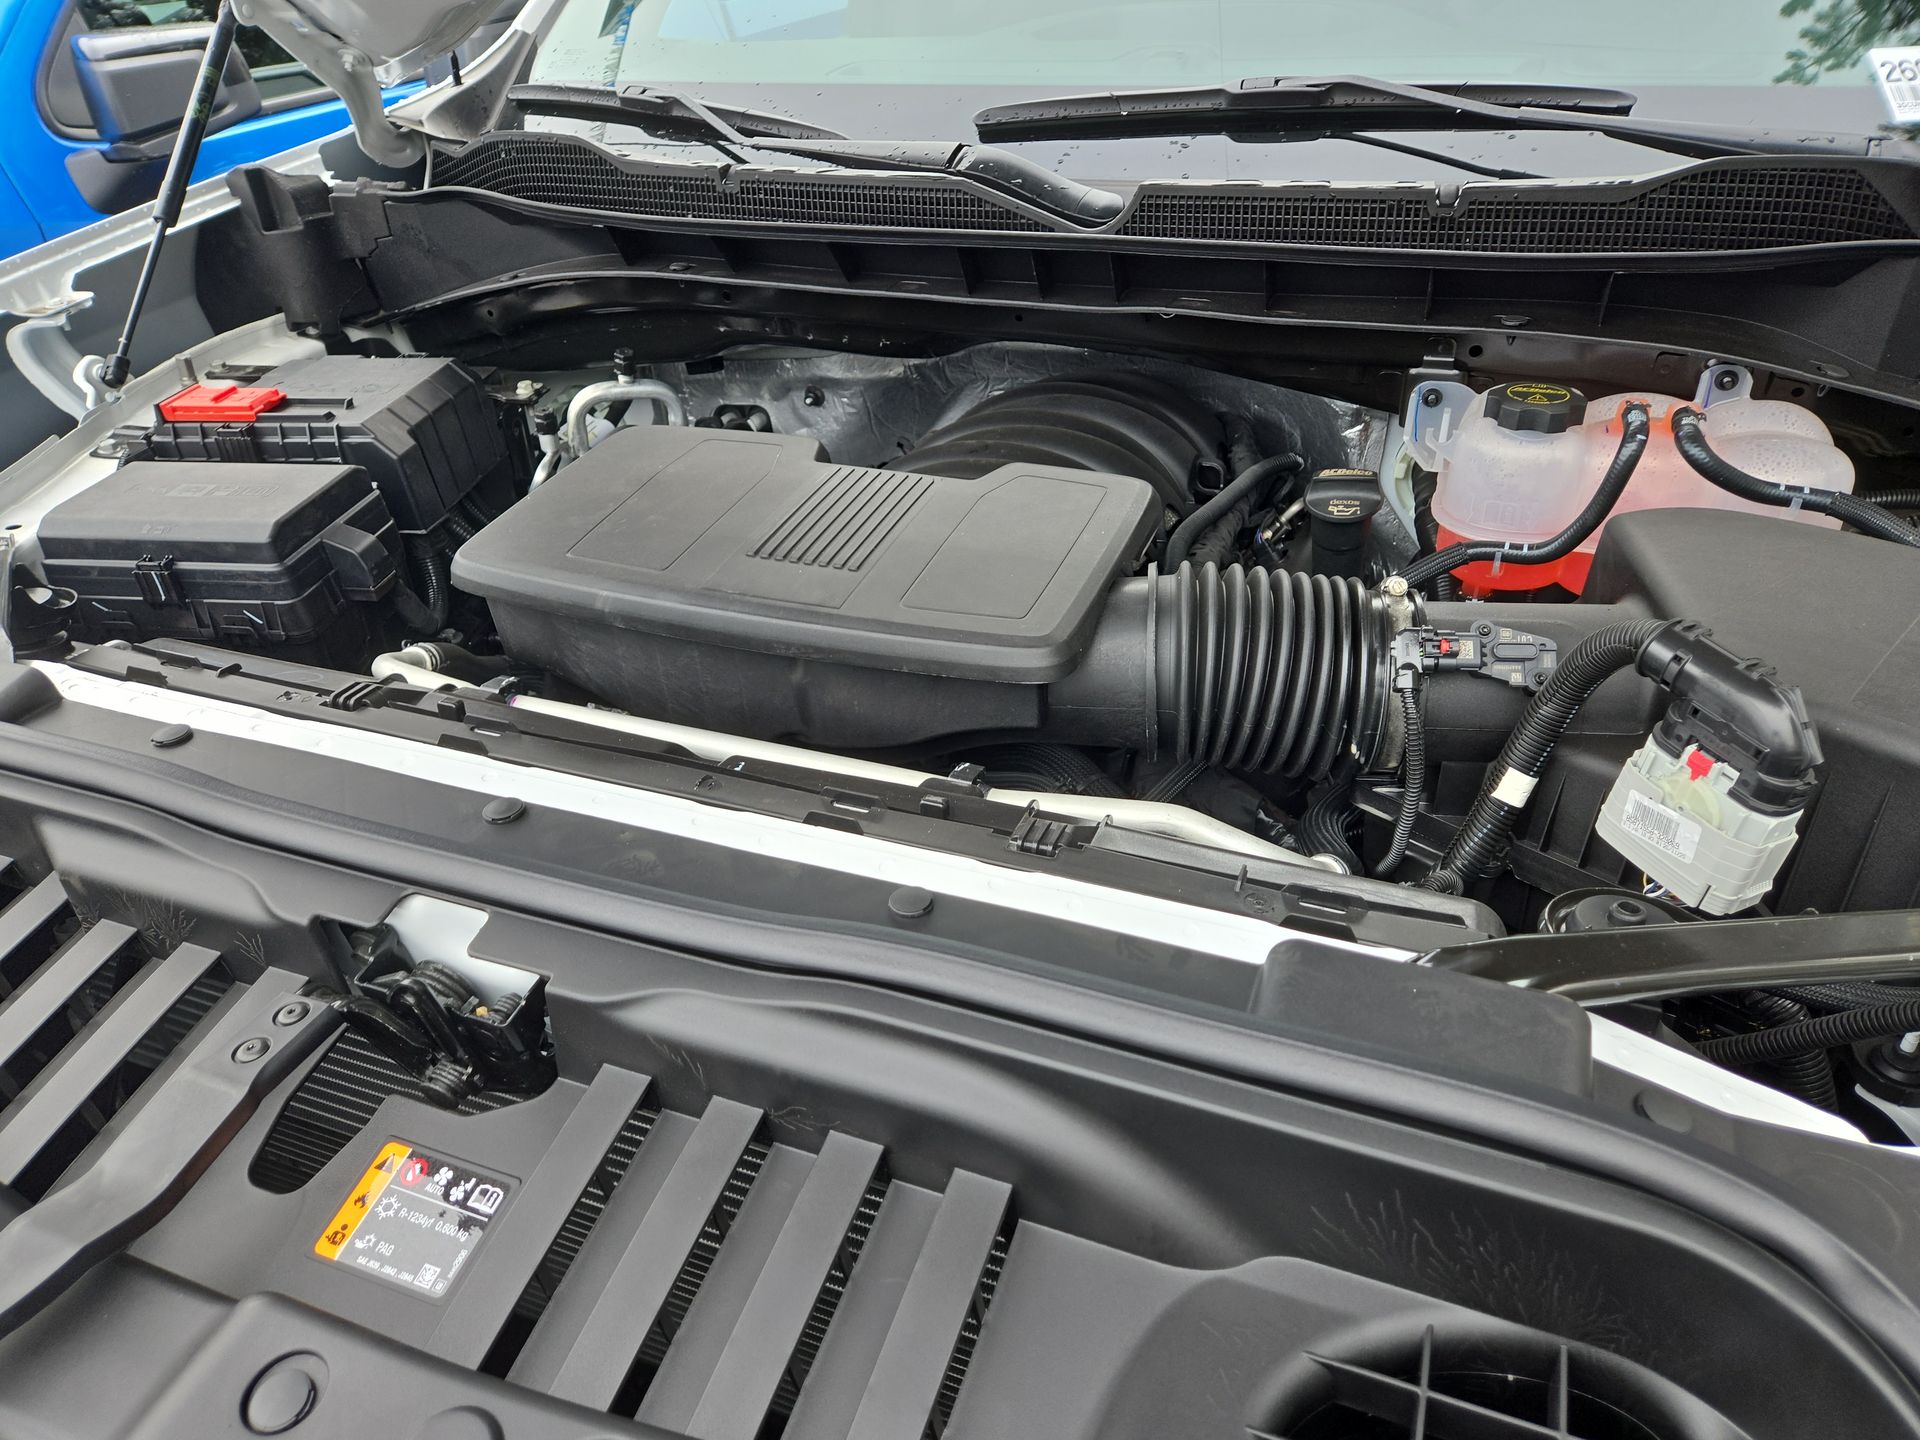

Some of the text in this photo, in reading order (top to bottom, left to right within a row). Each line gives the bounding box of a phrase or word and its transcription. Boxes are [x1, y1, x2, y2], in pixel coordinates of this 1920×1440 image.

[1880, 58, 1920, 82] 26
[1318, 468, 1374, 477] ACDelco
[425, 1182, 444, 1195] AUTO
[398, 1208, 470, 1242] R-1234yf 0.600 kg
[375, 1241, 394, 1256] PAG
